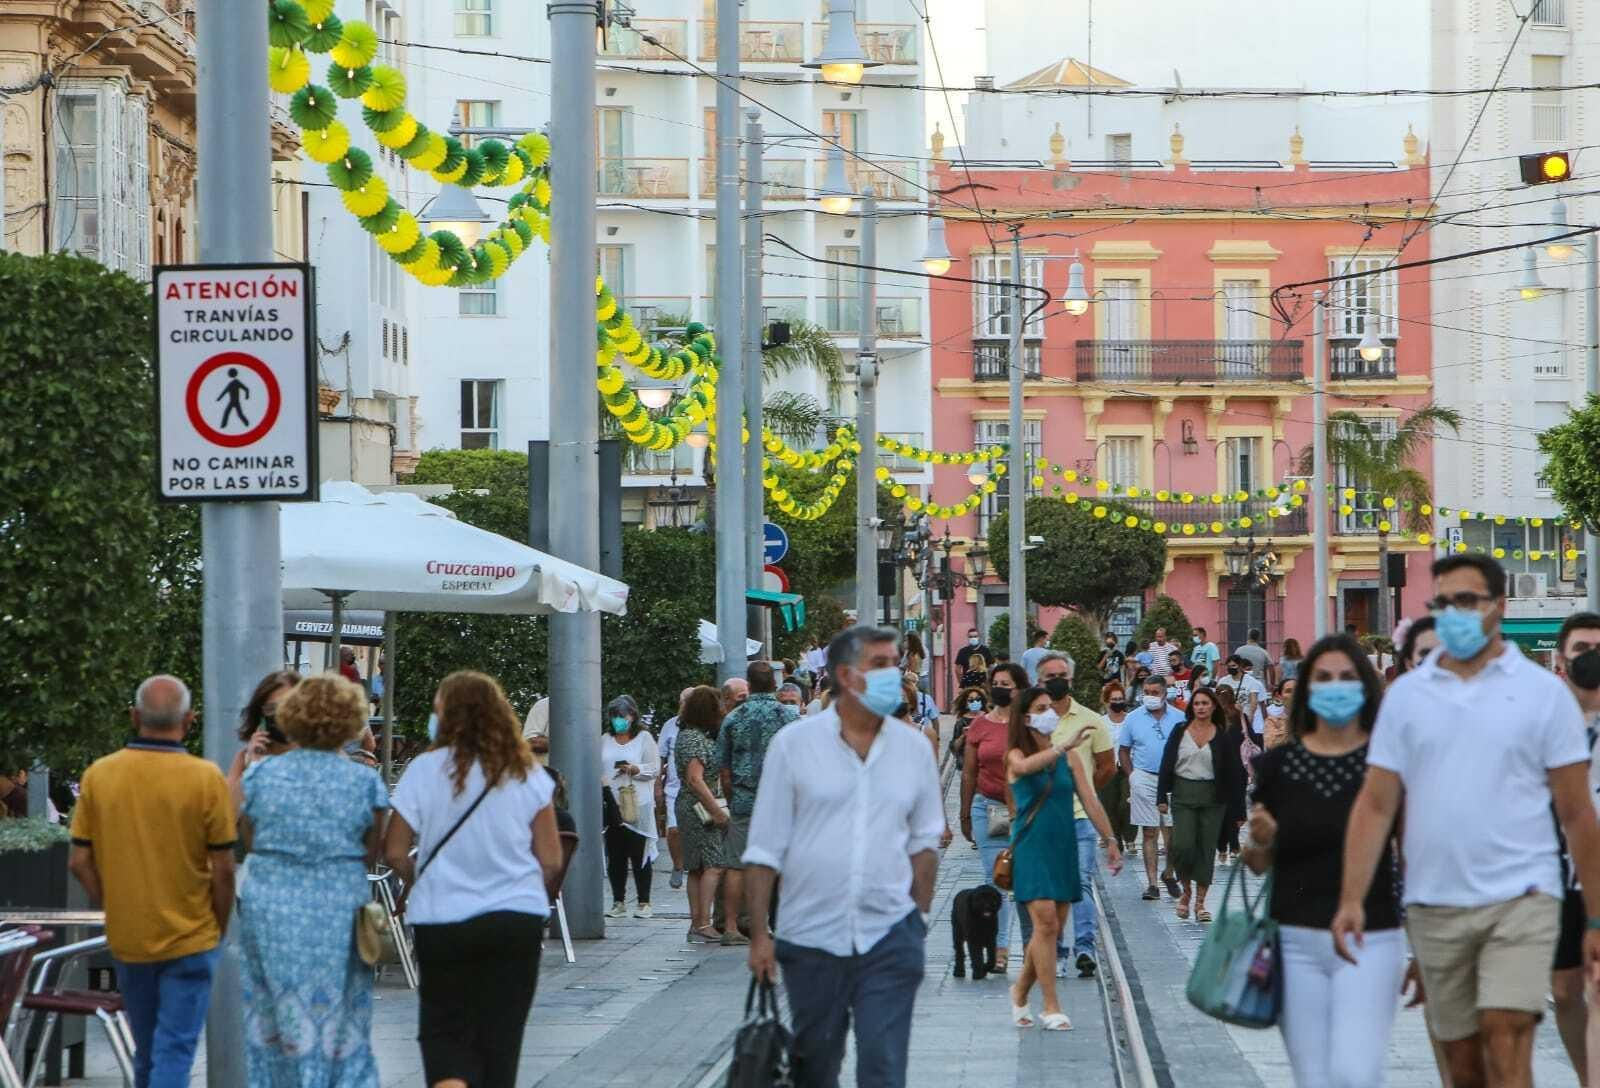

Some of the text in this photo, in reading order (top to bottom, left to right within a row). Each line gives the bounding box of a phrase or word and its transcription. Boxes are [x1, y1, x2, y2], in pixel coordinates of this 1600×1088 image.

[166, 274, 297, 299] ATENCIÓN
[184, 305, 278, 323] TRANVÍAS
[170, 328, 293, 343] CIRCULANDO
[173, 456, 294, 471] NO CAMINAR
[169, 472, 299, 490] POR LAS VÍAS
[426, 560, 516, 579] Cruzcampo
[441, 580, 493, 591] ESPECIAL
[295, 622, 334, 633] CERVEZA
